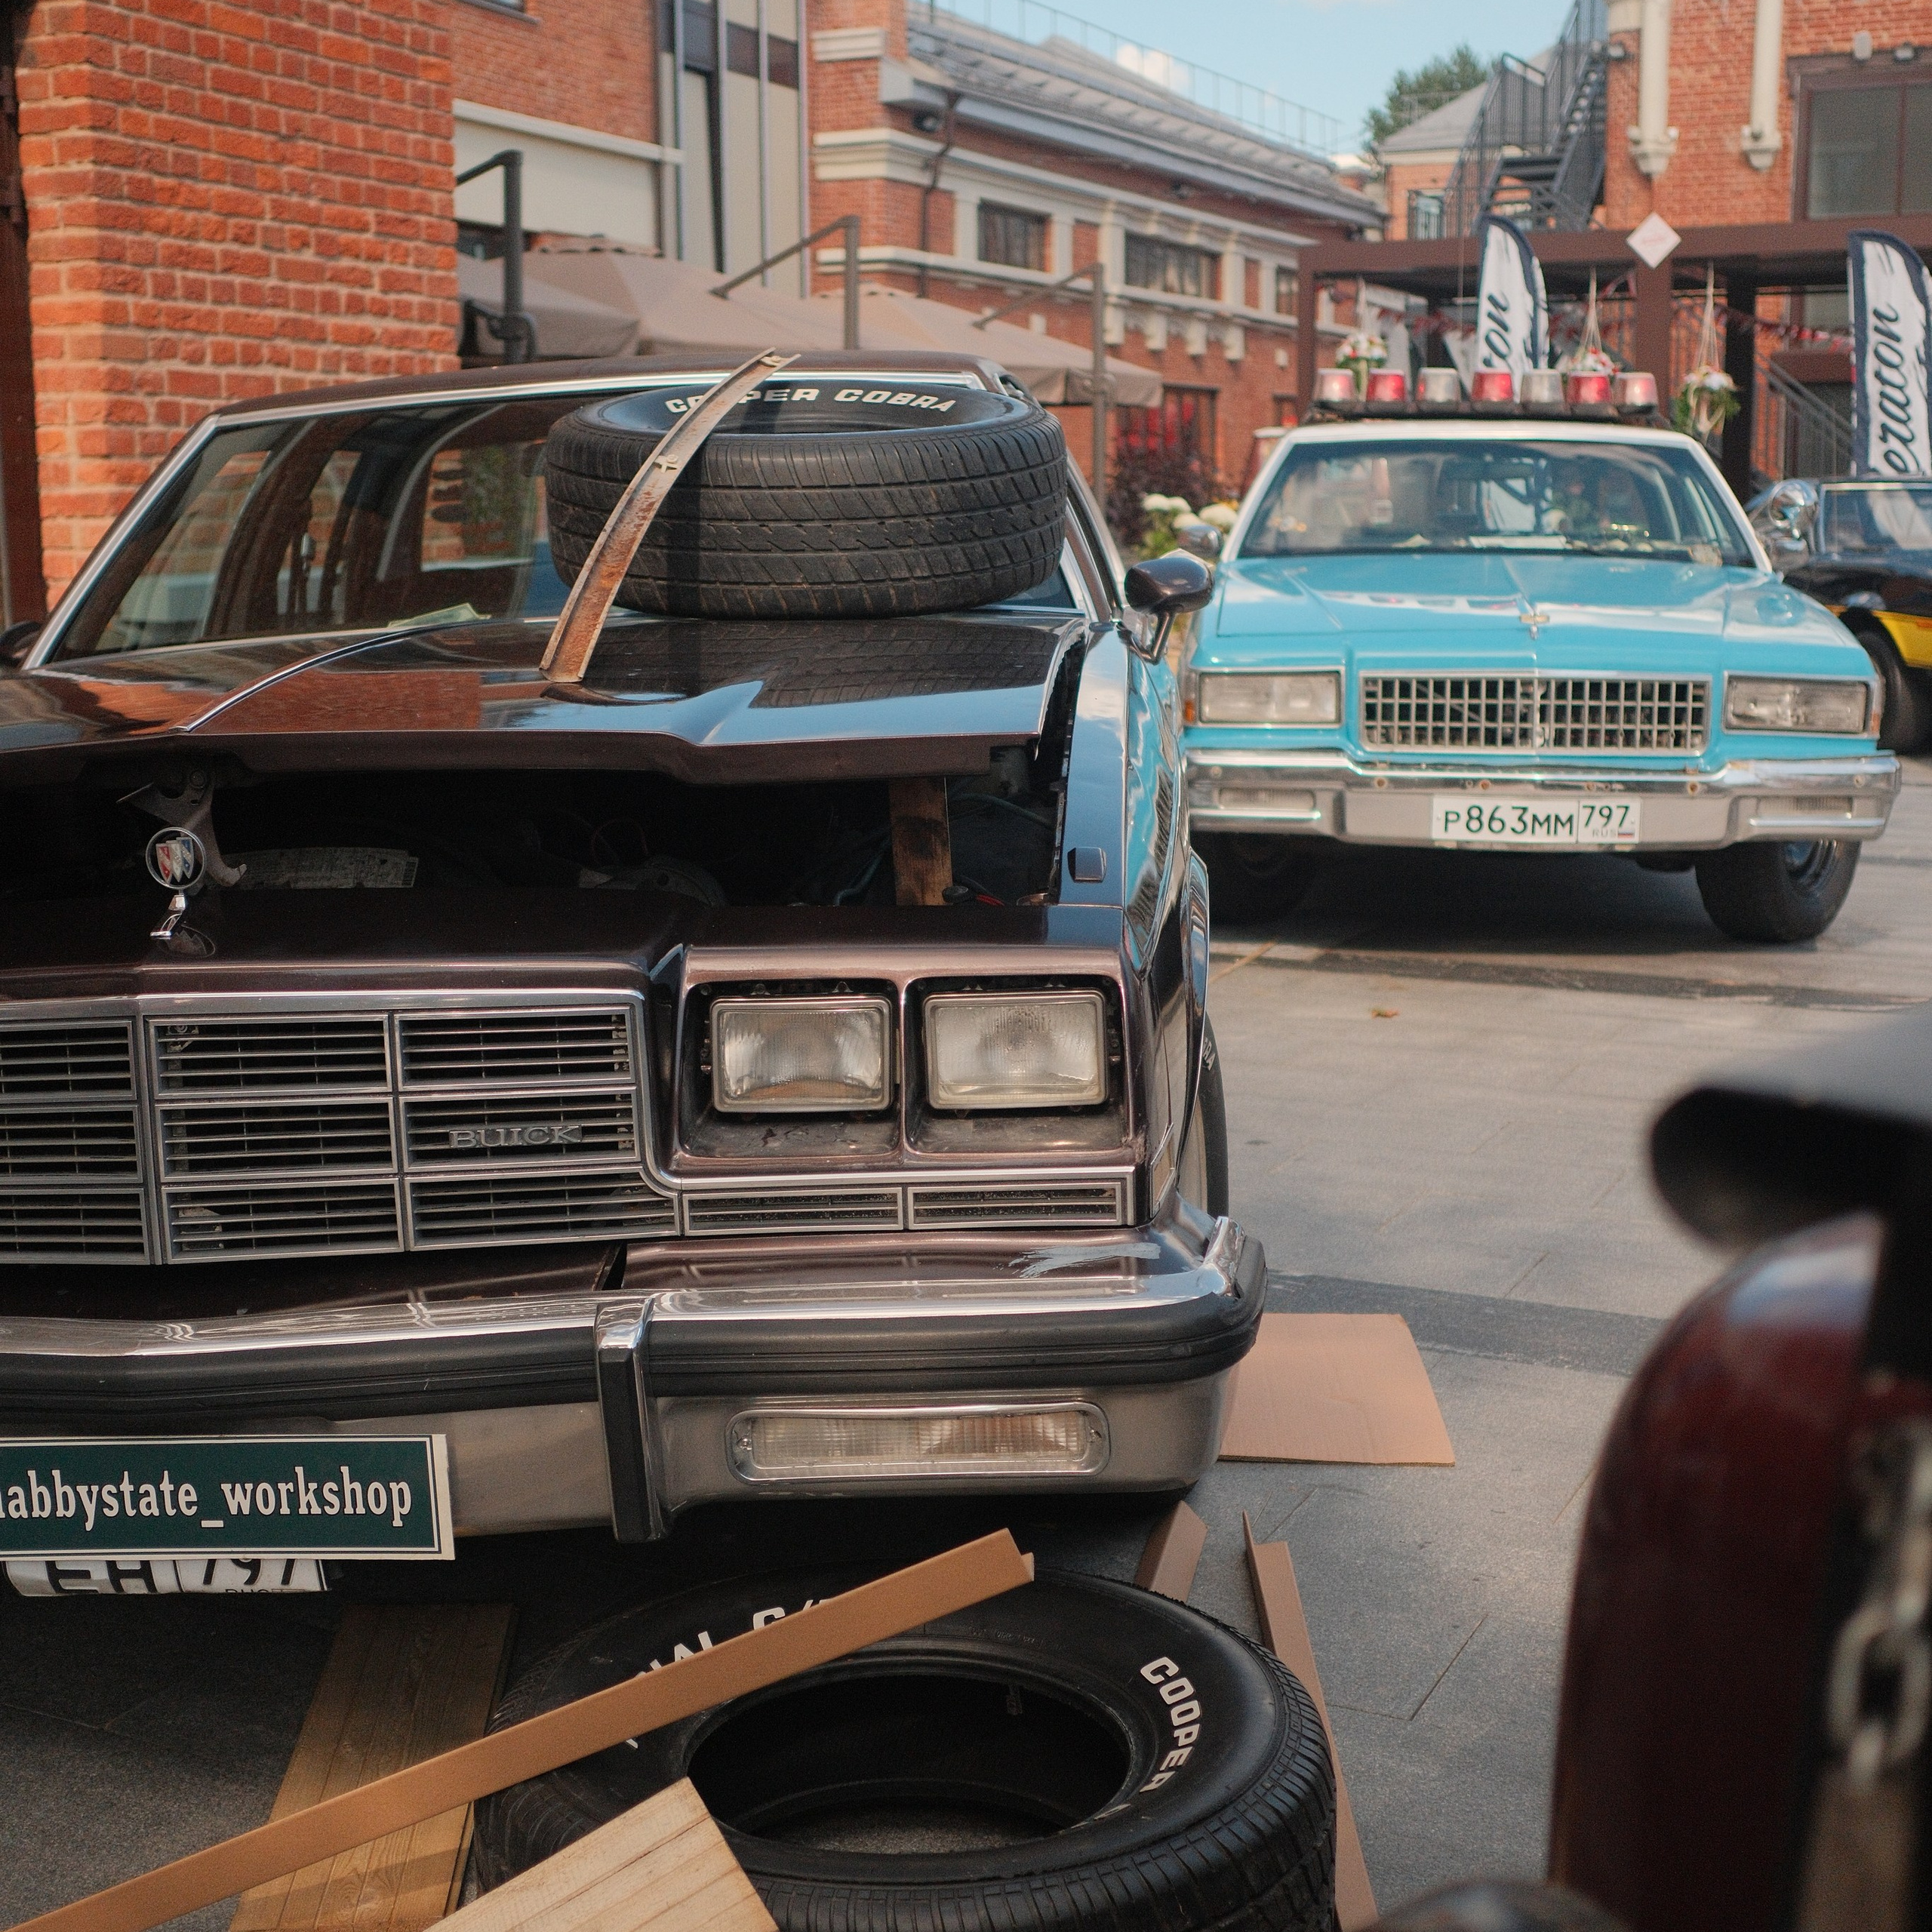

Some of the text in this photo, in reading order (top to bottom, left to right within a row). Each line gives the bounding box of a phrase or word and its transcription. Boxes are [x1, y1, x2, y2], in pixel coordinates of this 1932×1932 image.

[1483, 291, 1512, 368] on
[665, 389, 956, 413] CPER COBRA
[1444, 804, 1630, 835] P863MM 797
[449, 1125, 581, 1148] BUICK
[0, 1466, 411, 1531] abbystate_workshop
[1139, 1657, 1201, 1792] COOPER
